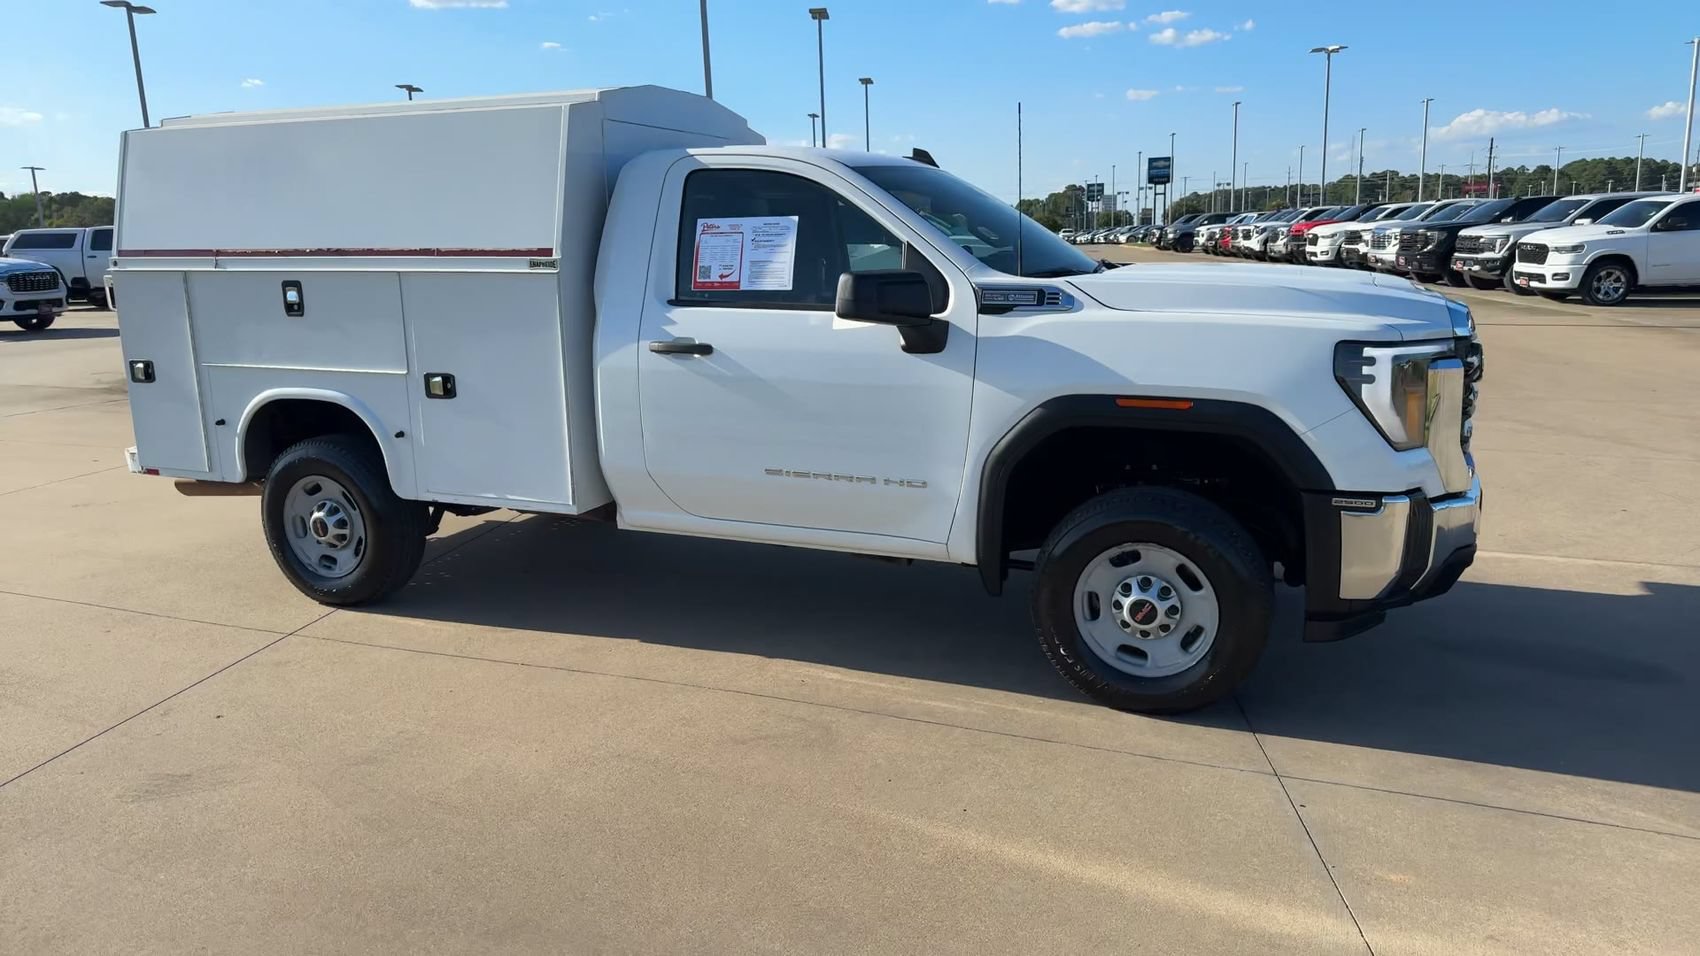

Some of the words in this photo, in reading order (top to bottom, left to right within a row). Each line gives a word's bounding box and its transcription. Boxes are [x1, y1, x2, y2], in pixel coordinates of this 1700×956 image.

[764, 467, 877, 484] SIERRA
[883, 477, 928, 489] HD
[1333, 499, 1375, 507] 2500
